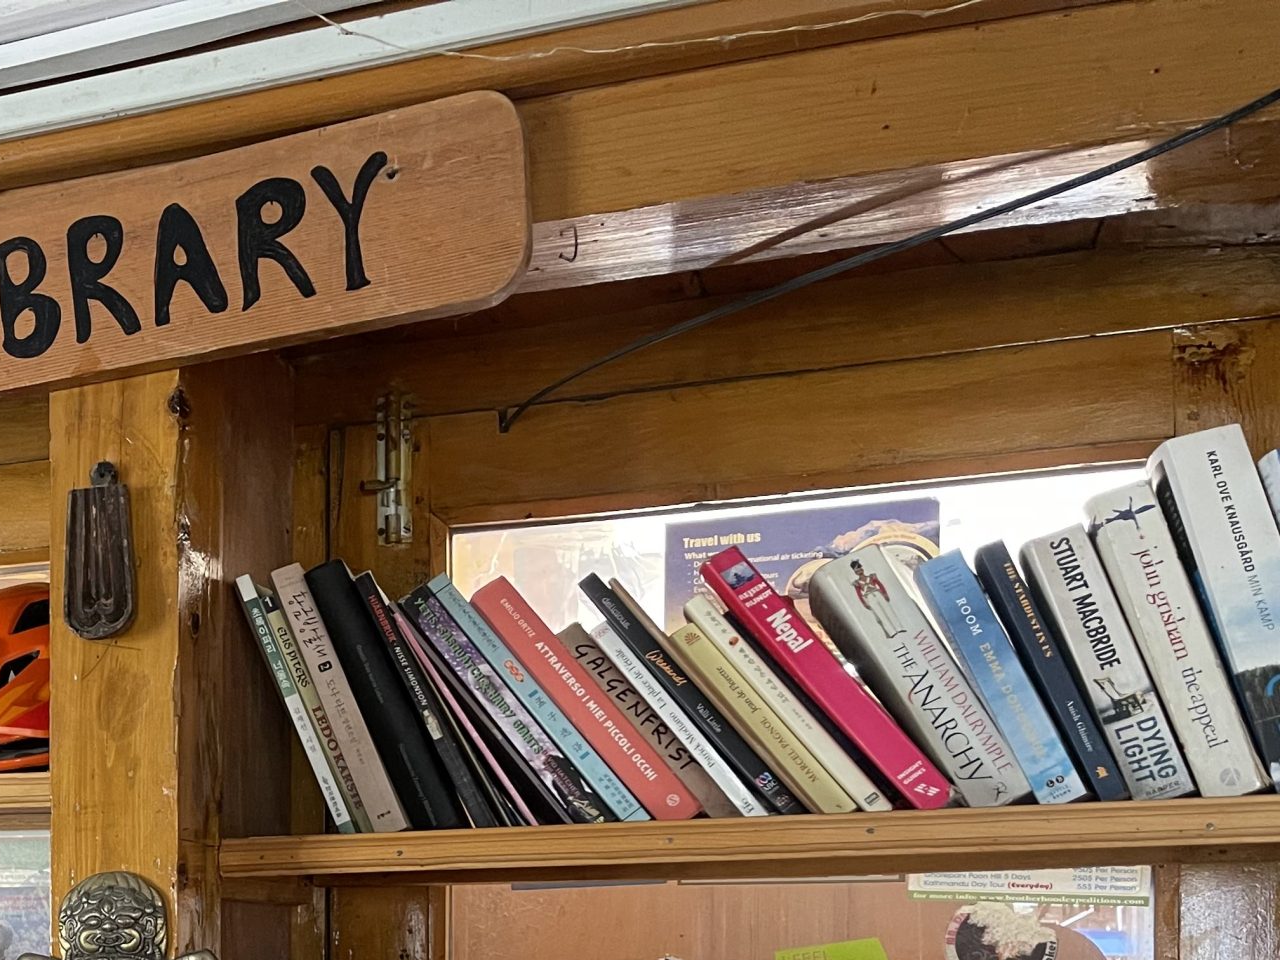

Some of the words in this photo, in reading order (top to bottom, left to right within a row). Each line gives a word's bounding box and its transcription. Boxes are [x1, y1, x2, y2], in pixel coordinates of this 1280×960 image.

[1206, 450, 1224, 479] KARL
[1217, 480, 1232, 503] OVE
[683, 535, 718, 548] Travel
[720, 533, 745, 544] with
[747, 532, 761, 543] us
[1224, 503, 1256, 572] KNAUSGÅRD
[1050, 537, 1084, 592] STUART
[1073, 593, 1121, 671] MACBRIDE
[1247, 574, 1262, 599] MIN
[1255, 598, 1276, 631] KAMP
[893, 642, 918, 671] THE
[575, 644, 700, 770] GALGENFRIST
[912, 629, 959, 693] WILLIAM
[951, 691, 1014, 775] DALRYMPLE
[902, 671, 993, 781] ANARCHY
[1137, 716, 1178, 780] DYING
[1114, 725, 1155, 782] LIGHT
[973, 881, 988, 889] Day
[1008, 882, 1052, 890] (Everyday)
